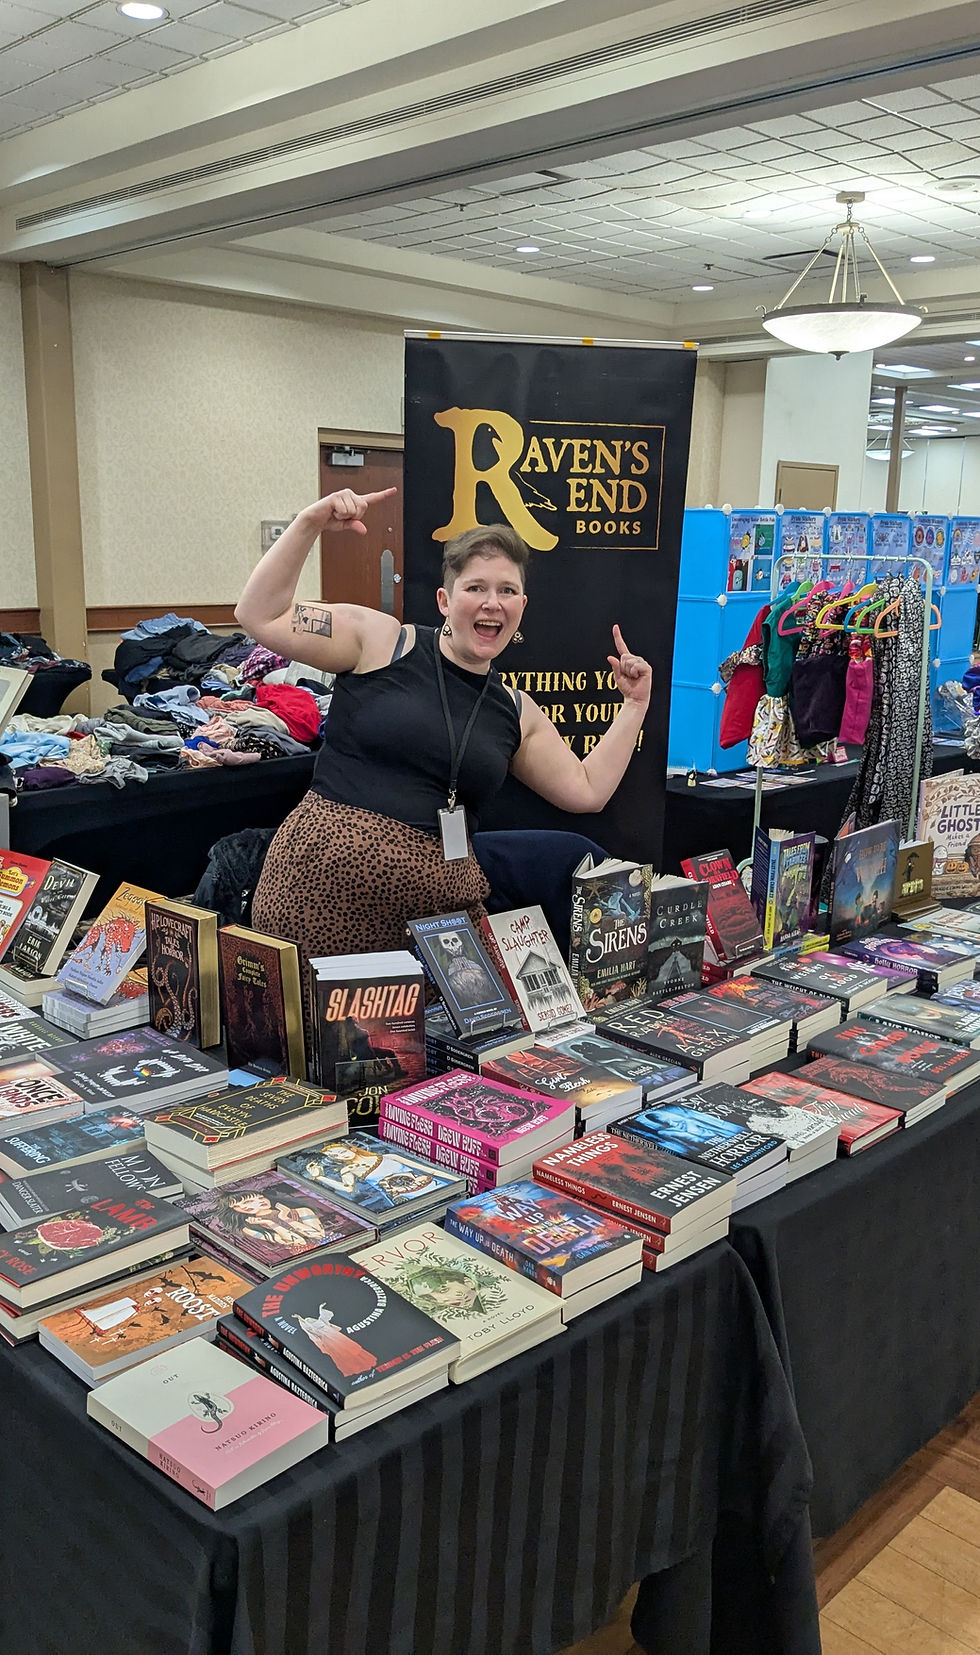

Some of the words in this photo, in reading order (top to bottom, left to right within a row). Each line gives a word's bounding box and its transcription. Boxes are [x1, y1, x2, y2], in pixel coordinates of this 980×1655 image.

[432, 406, 650, 551] RAVEN'S
[566, 478, 648, 513] END
[575, 520, 642, 535] BOOKS
[498, 671, 587, 692] RYTHING
[595, 671, 619, 690] YO
[540, 703, 566, 723] OR
[699, 858, 733, 876] CLOWN
[0, 880, 19, 891] emons
[43, 875, 76, 891] DEVIL
[572, 894, 585, 932] SIRENS
[656, 900, 703, 916] CURDLE
[415, 922, 440, 932] NIGHT
[510, 915, 531, 934] CAMP
[614, 918, 625, 930] THE
[659, 915, 699, 929] CREEK
[502, 929, 551, 952] SLAUGHTER
[586, 922, 647, 963] SIRENS
[237, 956, 265, 971] Grimm's
[597, 964, 619, 979] EMILIA
[620, 961, 636, 973] HART
[892, 962, 919, 976] HORROR
[326, 983, 420, 1022] SLASHTAG
[607, 1009, 665, 1033] RED
[1, 1022, 52, 1051] WHITE
[690, 1034, 740, 1058] GRECIAN
[14, 1080, 64, 1103] ONCE
[359, 1085, 388, 1097] JON
[534, 1072, 568, 1090] Girl
[559, 1078, 591, 1092] Flesh
[244, 1096, 279, 1110] DEATHS
[260, 1092, 290, 1105] SEVEN
[276, 1089, 296, 1098] THE
[218, 1104, 252, 1119] EVELYN
[240, 1103, 256, 1111] OF
[348, 1097, 380, 1116] CO
[388, 1104, 411, 1128] DIVINE
[411, 1114, 434, 1137] FLESH
[437, 1124, 461, 1149] DREW
[462, 1134, 482, 1157] HUFF
[610, 1127, 622, 1137] THE
[705, 1134, 726, 1146] THE
[5, 1137, 51, 1164] SUFFERING
[386, 1123, 408, 1144] DIVINE
[408, 1133, 432, 1153] FLESH
[435, 1144, 459, 1168] DREW
[460, 1154, 480, 1177] HUFF
[542, 1132, 612, 1167] NAMELESS
[566, 1141, 619, 1168] THINGS
[698, 1131, 754, 1161] NETHERWELL
[710, 1135, 771, 1167] HORROR
[730, 1162, 743, 1171] LEE
[743, 1140, 779, 1165] MOUNTFORD
[649, 1170, 702, 1200] ERNEST
[668, 1176, 723, 1208] JENSEN
[536, 1170, 565, 1187] NAMELESS
[564, 1181, 586, 1195] THINGS
[611, 1200, 633, 1214] ERNEST
[634, 1208, 657, 1224] JENSEN
[90, 1198, 158, 1230] LAMB
[495, 1199, 542, 1222] WAY
[524, 1212, 545, 1225] UP
[450, 1218, 458, 1228] THE
[458, 1222, 474, 1238] WAY
[475, 1232, 484, 1244] UP
[491, 1242, 514, 1263] DEATH
[521, 1214, 605, 1254] DEATH
[358, 1231, 444, 1273] ERVOR
[6, 1256, 38, 1275] ROSE
[272, 1263, 367, 1293] UNWORTHY
[165, 1286, 221, 1320] ROOST
[360, 1276, 388, 1307] BAZTERRICA
[261, 1294, 284, 1318] THE
[277, 1319, 298, 1335] NOVEL
[346, 1307, 385, 1334] AGUSTINA
[466, 1324, 497, 1342] TOBY
[499, 1304, 536, 1325] LLOYD
[162, 1373, 180, 1385] OUT
[283, 1347, 302, 1371] AGUSTINA
[302, 1366, 328, 1393] BAZTERRICA
[351, 1374, 368, 1386] author
[369, 1369, 377, 1379] of
[270, 1366, 291, 1388] AGUSTINA
[291, 1383, 318, 1409] BAZTERRICA
[111, 1420, 122, 1433] OUT
[215, 1430, 247, 1452] NATSUO
[249, 1412, 277, 1431] KIRINO
[158, 1453, 181, 1474] NATSUO
